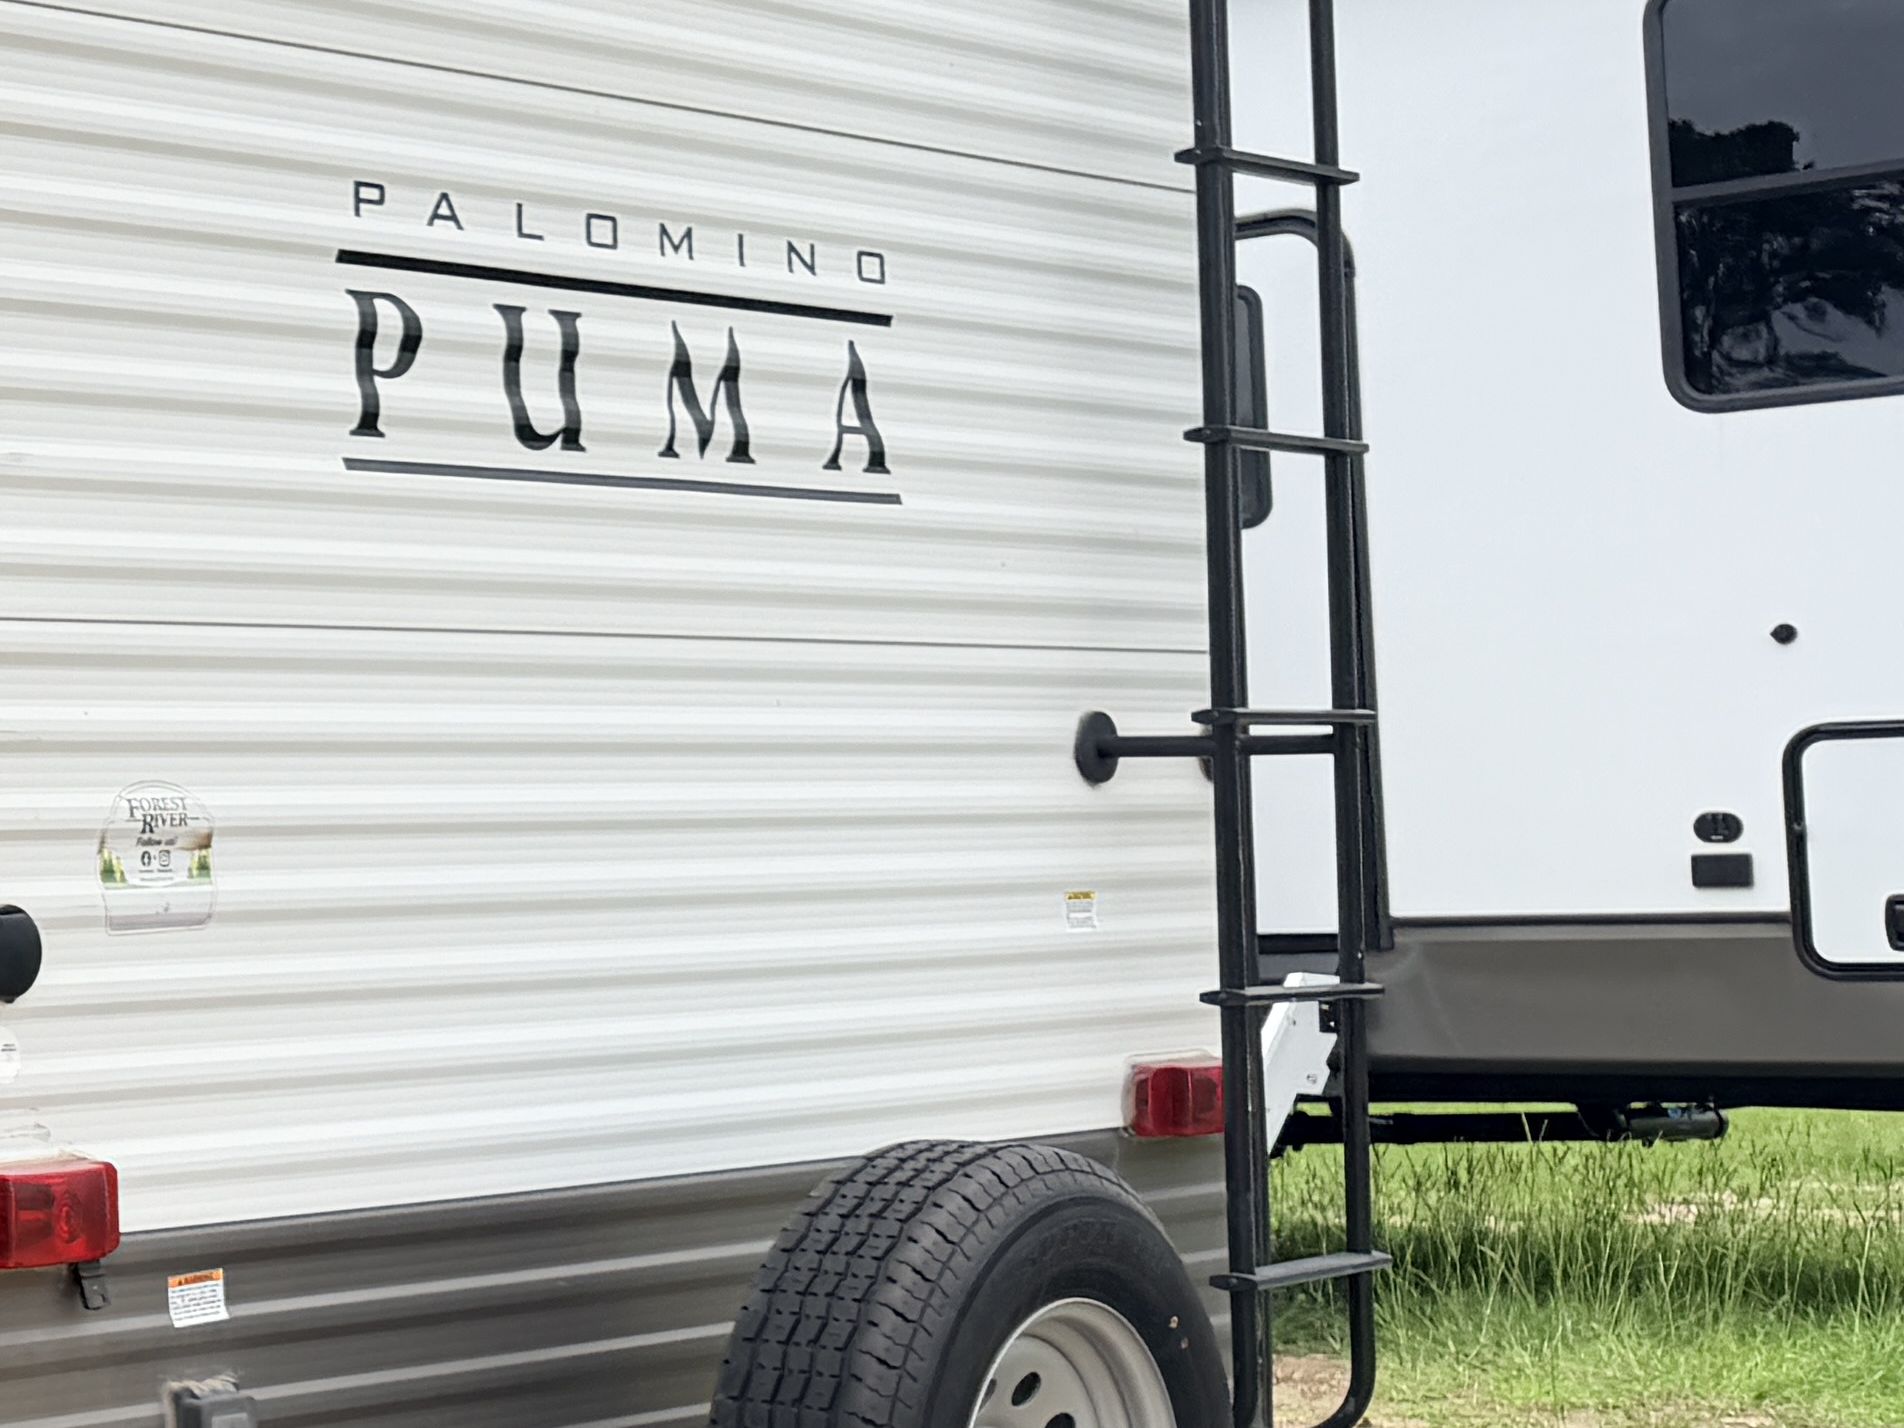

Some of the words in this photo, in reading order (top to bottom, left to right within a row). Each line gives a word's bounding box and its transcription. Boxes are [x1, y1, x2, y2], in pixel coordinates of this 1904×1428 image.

[352, 180, 887, 285] PALOMINO
[344, 288, 892, 475] PUMA
[125, 797, 188, 819] FOREST
[140, 812, 189, 835] RIVER
